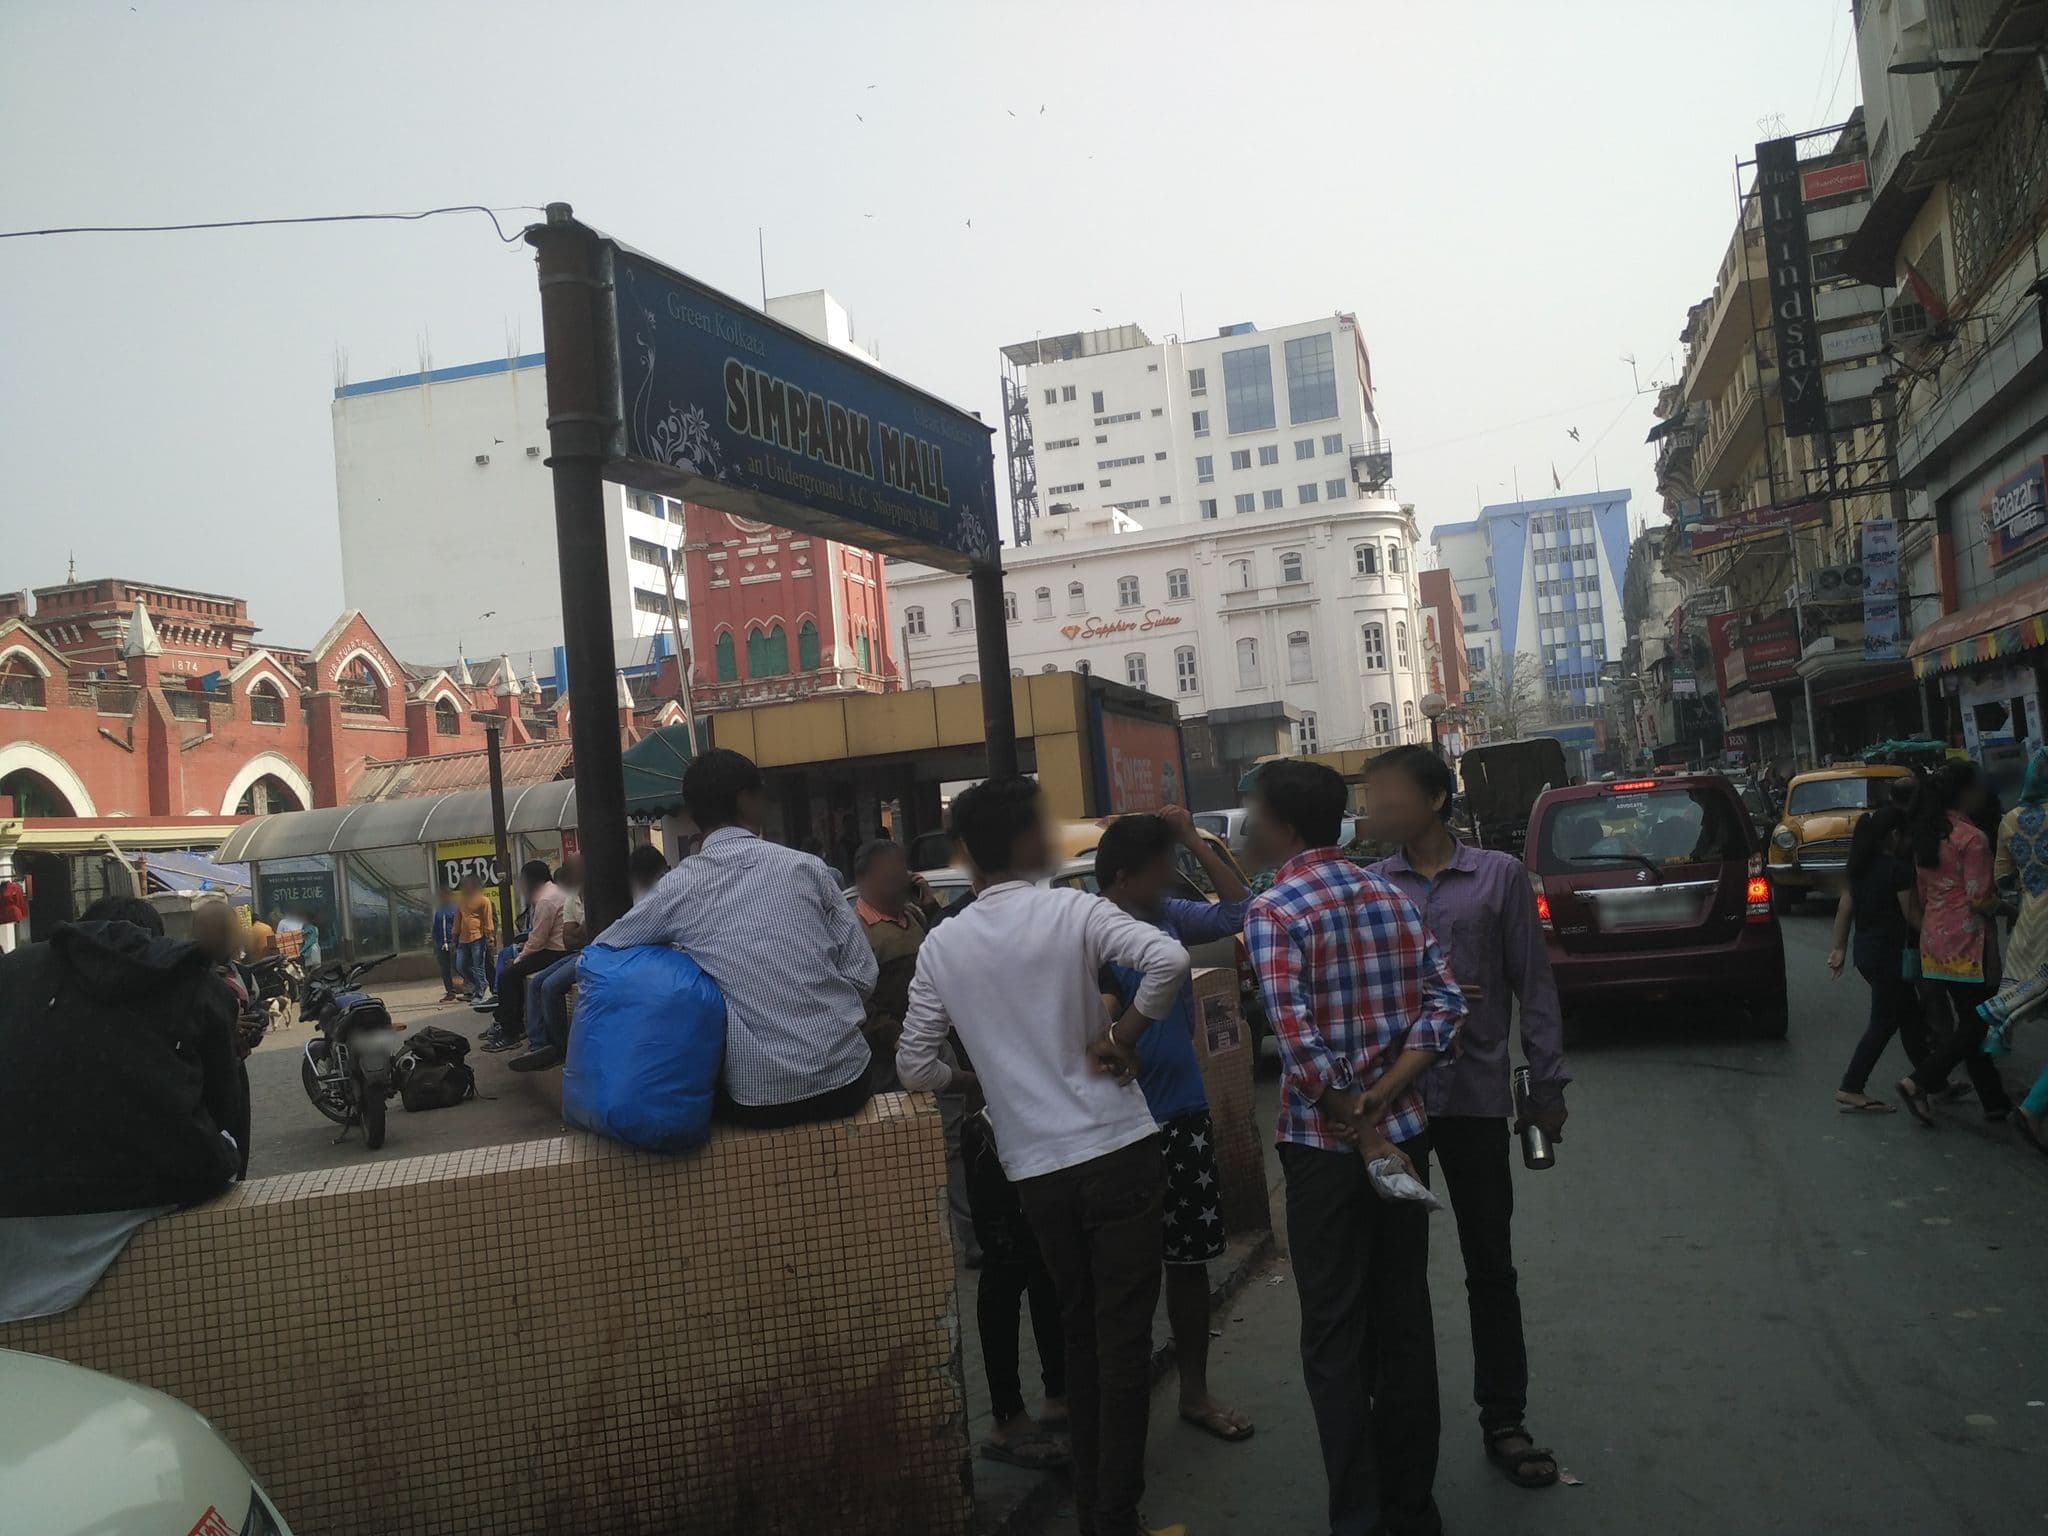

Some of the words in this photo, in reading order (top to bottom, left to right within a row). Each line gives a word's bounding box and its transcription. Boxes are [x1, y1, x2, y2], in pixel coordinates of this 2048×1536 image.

[1772, 194, 1811, 403] Lindsay
[667, 290, 713, 333] Green
[715, 312, 767, 358] Kolkata
[723, 356, 876, 481] SIMPARK
[878, 421, 951, 508] MALL
[747, 455, 764, 476] an
[765, 453, 845, 503] Underground
[872, 491, 918, 528] Shopping
[1992, 478, 2035, 527] Baazar
[1081, 616, 1138, 639] Sapphire
[1139, 609, 1183, 632] Suites
[172, 658, 199, 672] 1874
[335, 638, 362, 664] STUART
[377, 653, 398, 687] MARKET
[273, 887, 300, 902] STYLE
[302, 885, 324, 900] ZONE
